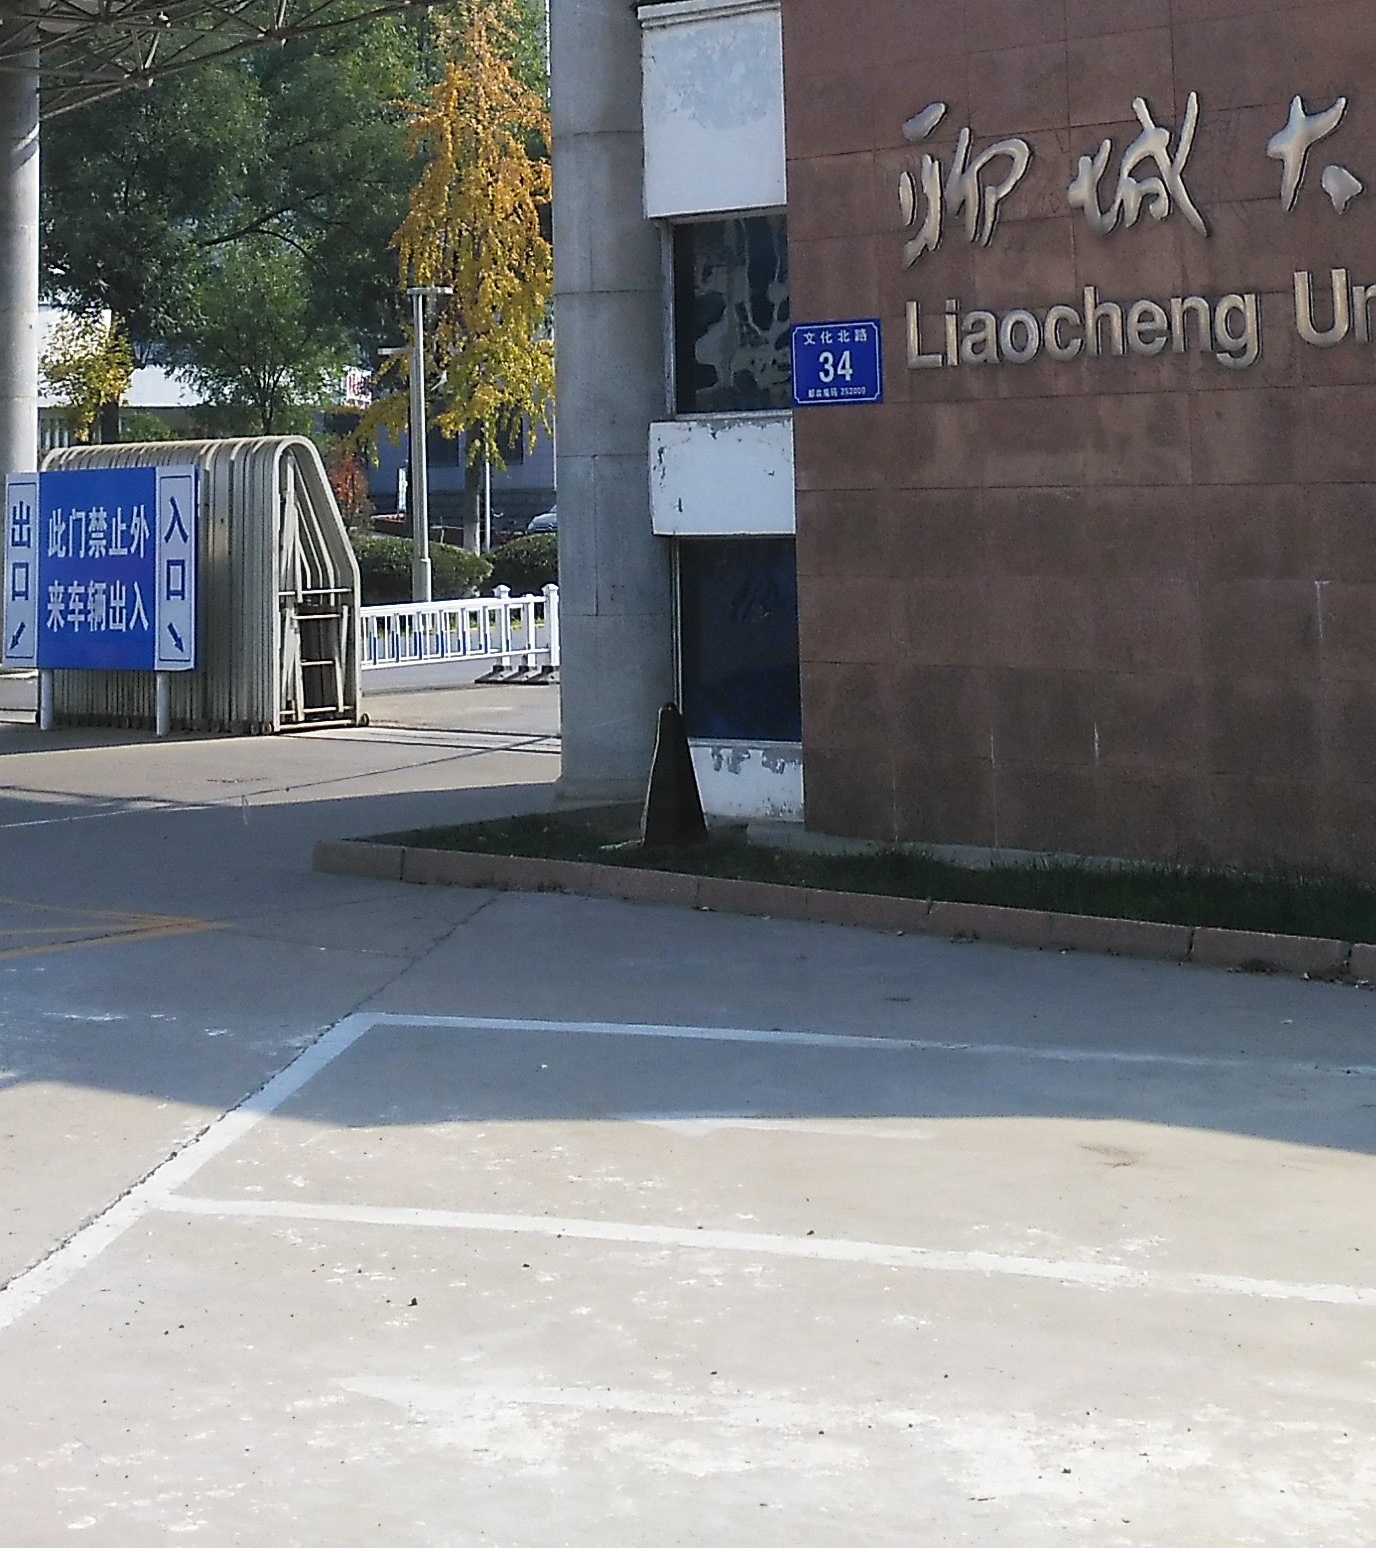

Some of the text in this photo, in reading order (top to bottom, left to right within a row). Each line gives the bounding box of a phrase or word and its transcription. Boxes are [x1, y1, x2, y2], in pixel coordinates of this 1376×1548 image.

[803, 328, 867, 345] 文化北路
[906, 286, 1261, 369] Liaocheng
[818, 350, 853, 383] 34
[11, 500, 31, 601] 出口
[47, 504, 150, 558] 此门禁止外
[164, 496, 189, 600] 入口
[46, 580, 149, 632] 来车辆出入
